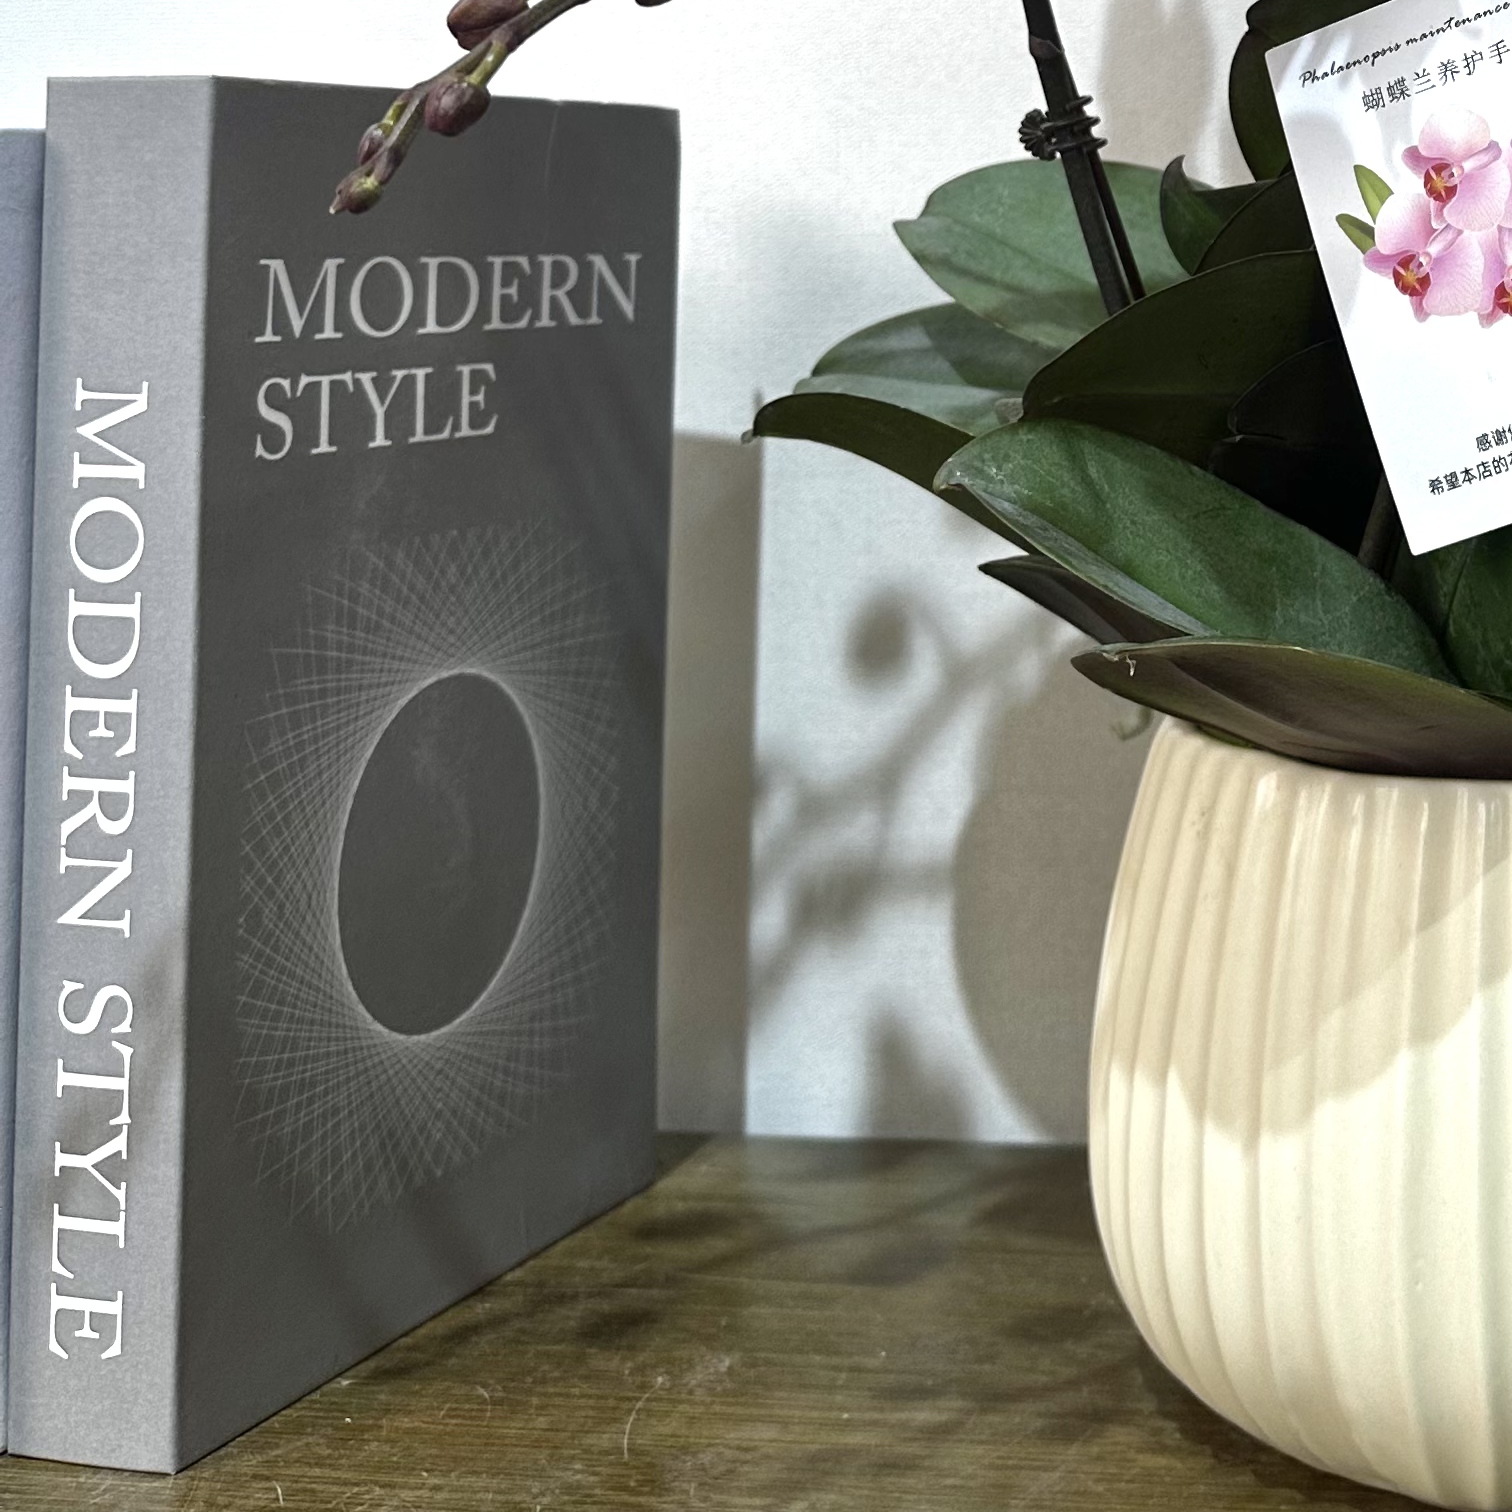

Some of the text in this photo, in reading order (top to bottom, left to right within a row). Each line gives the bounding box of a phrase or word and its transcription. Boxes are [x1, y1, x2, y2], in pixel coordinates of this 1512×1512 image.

[1300, 42, 1402, 88] Phalaenopsis
[1406, 13, 1511, 46] maintenance
[255, 252, 641, 343] MODERN
[255, 362, 498, 461] STYLE
[48, 377, 149, 1359] MODERN STYLE
